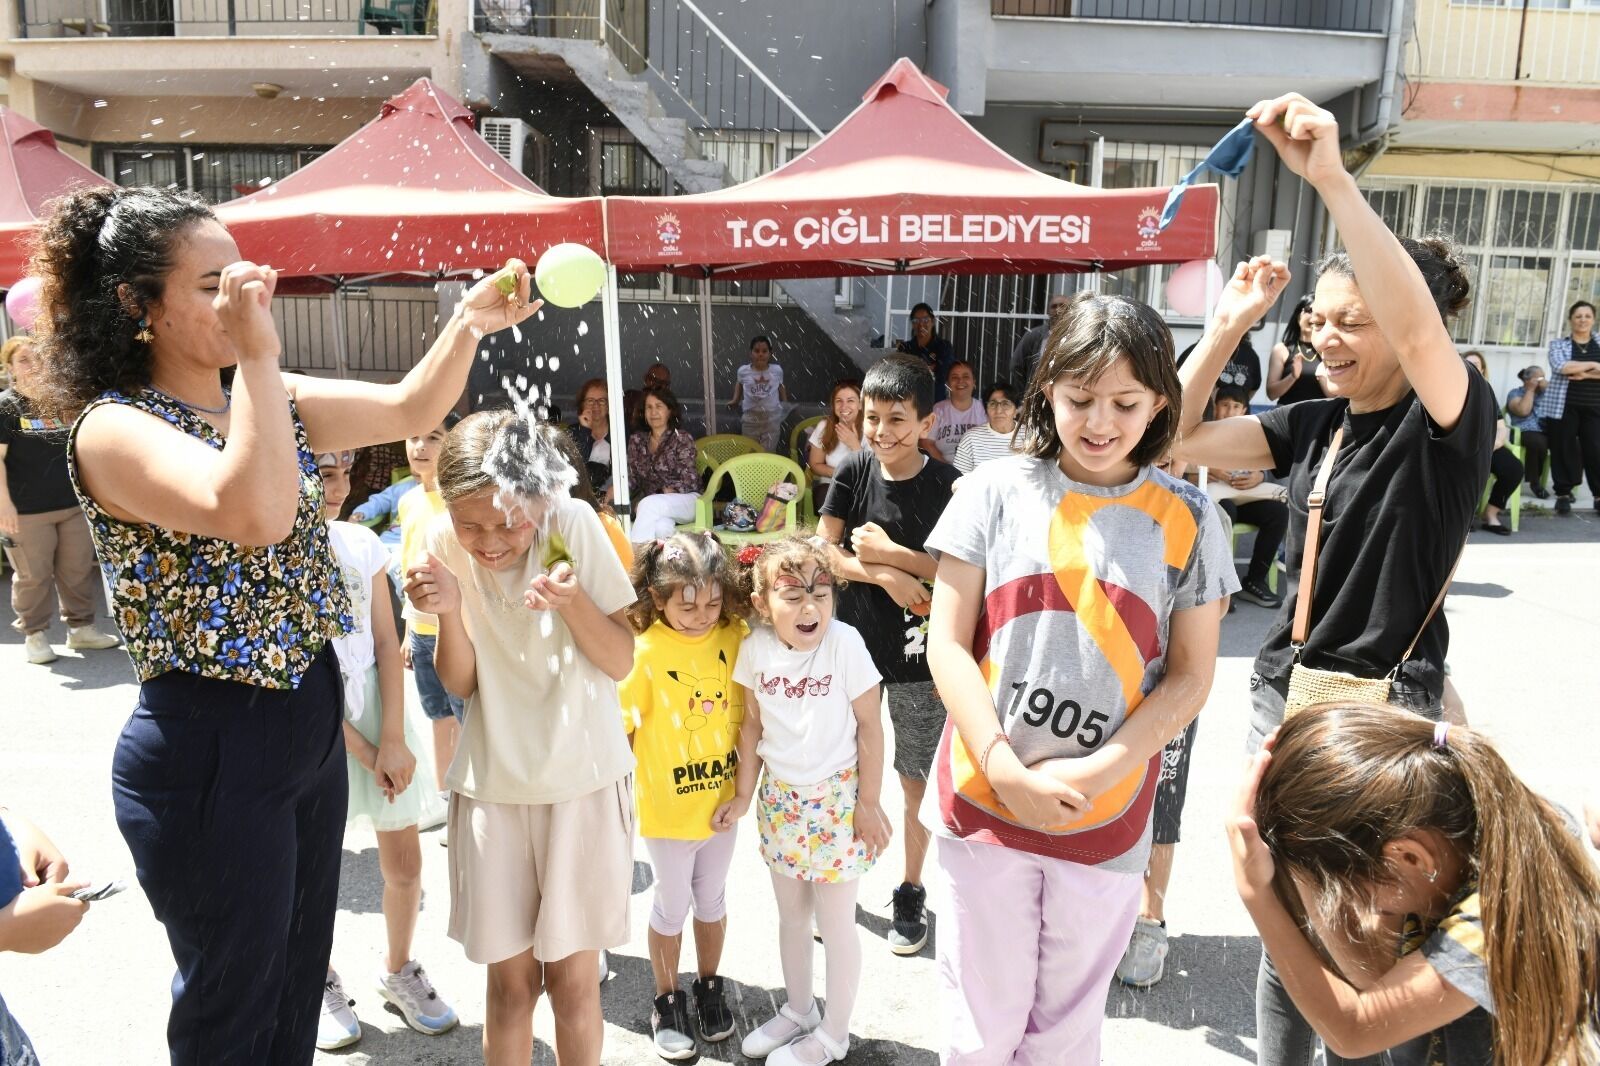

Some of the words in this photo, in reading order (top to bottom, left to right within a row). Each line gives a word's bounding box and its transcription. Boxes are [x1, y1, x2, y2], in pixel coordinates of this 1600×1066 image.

[726, 219, 788, 248] T.C.
[1008, 680, 1110, 749] 1905
[676, 782, 706, 795] GOTTA
